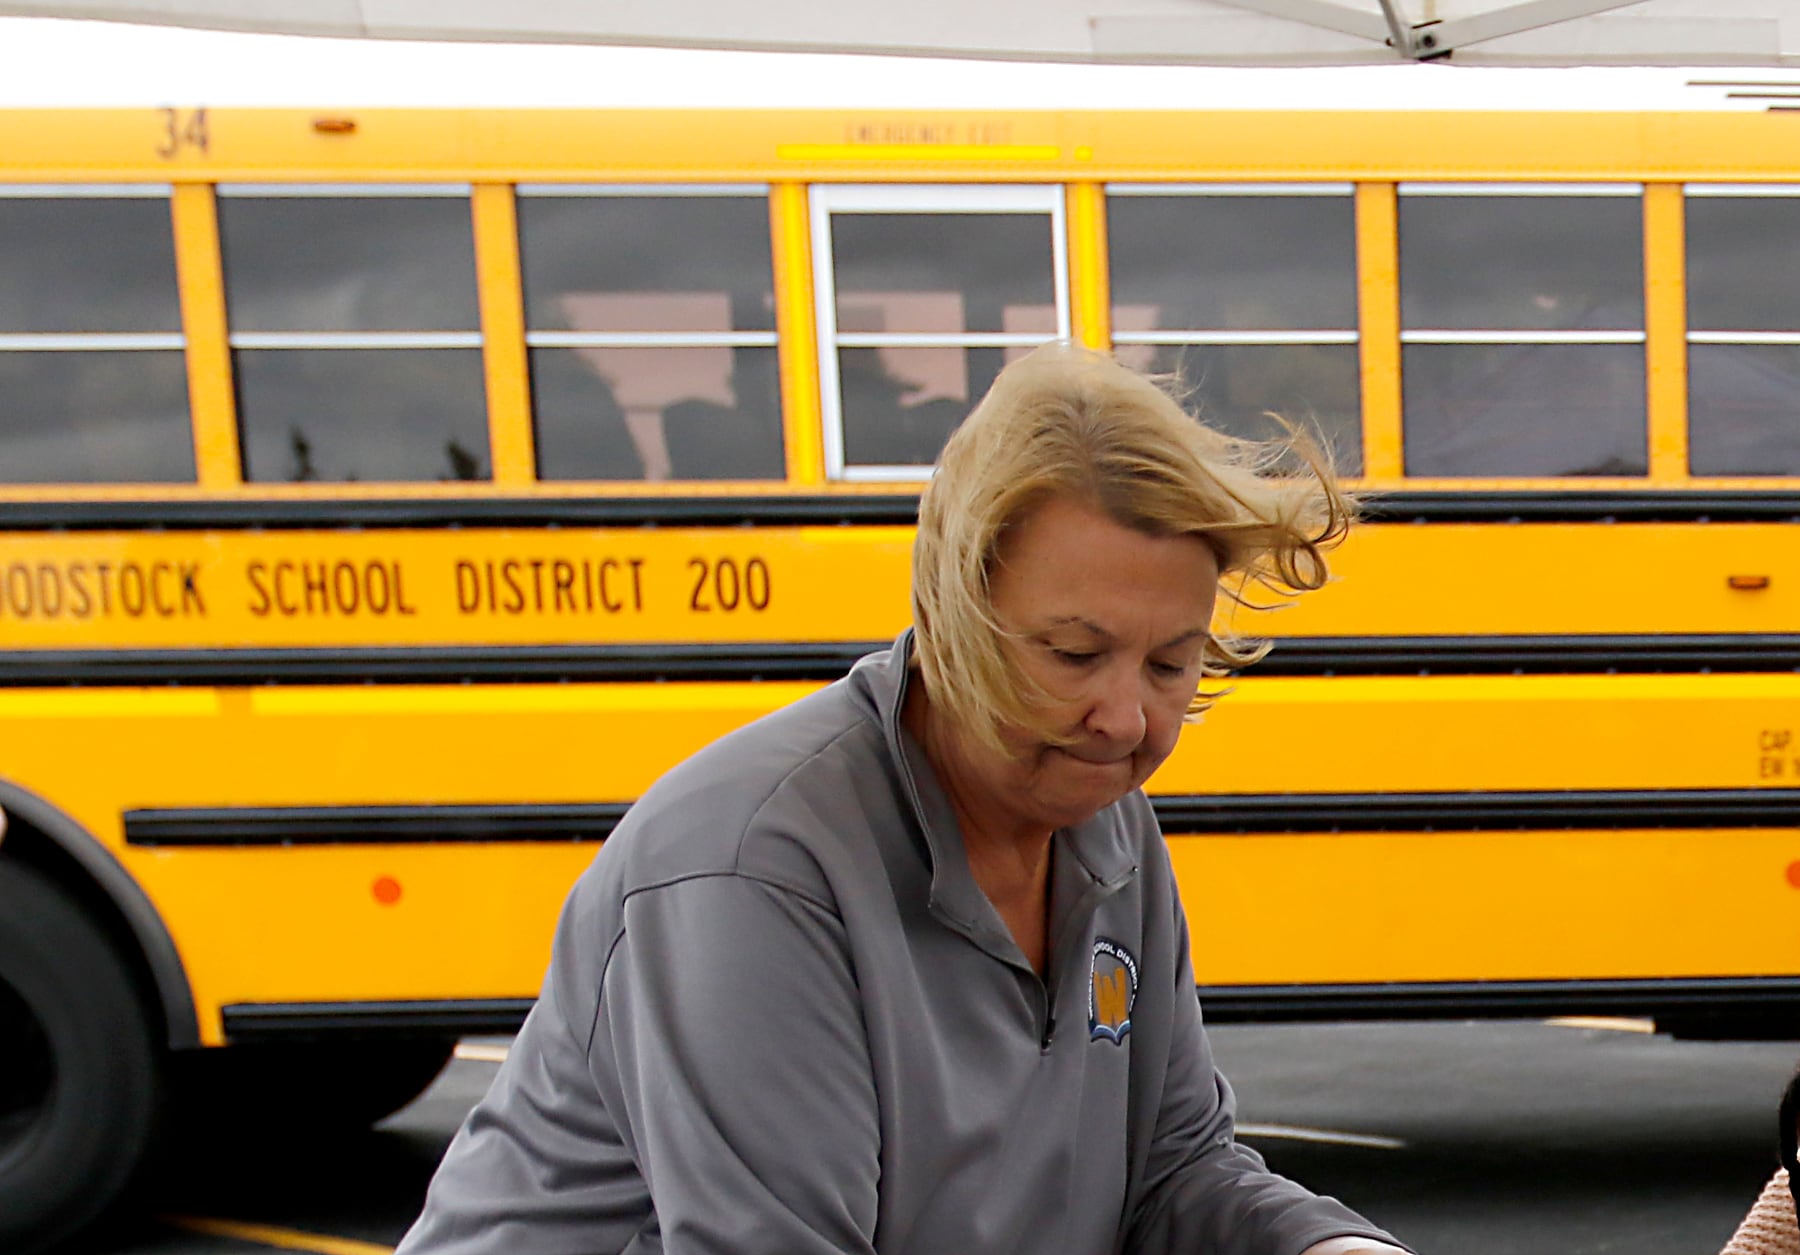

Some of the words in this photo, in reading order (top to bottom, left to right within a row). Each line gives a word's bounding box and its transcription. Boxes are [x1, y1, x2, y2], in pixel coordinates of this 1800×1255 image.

[154, 104, 211, 161] 34
[0, 560, 208, 619] ODSTOCK
[246, 559, 416, 618] SCHOOL
[454, 556, 646, 615] DISTRICT
[687, 555, 772, 613] 200
